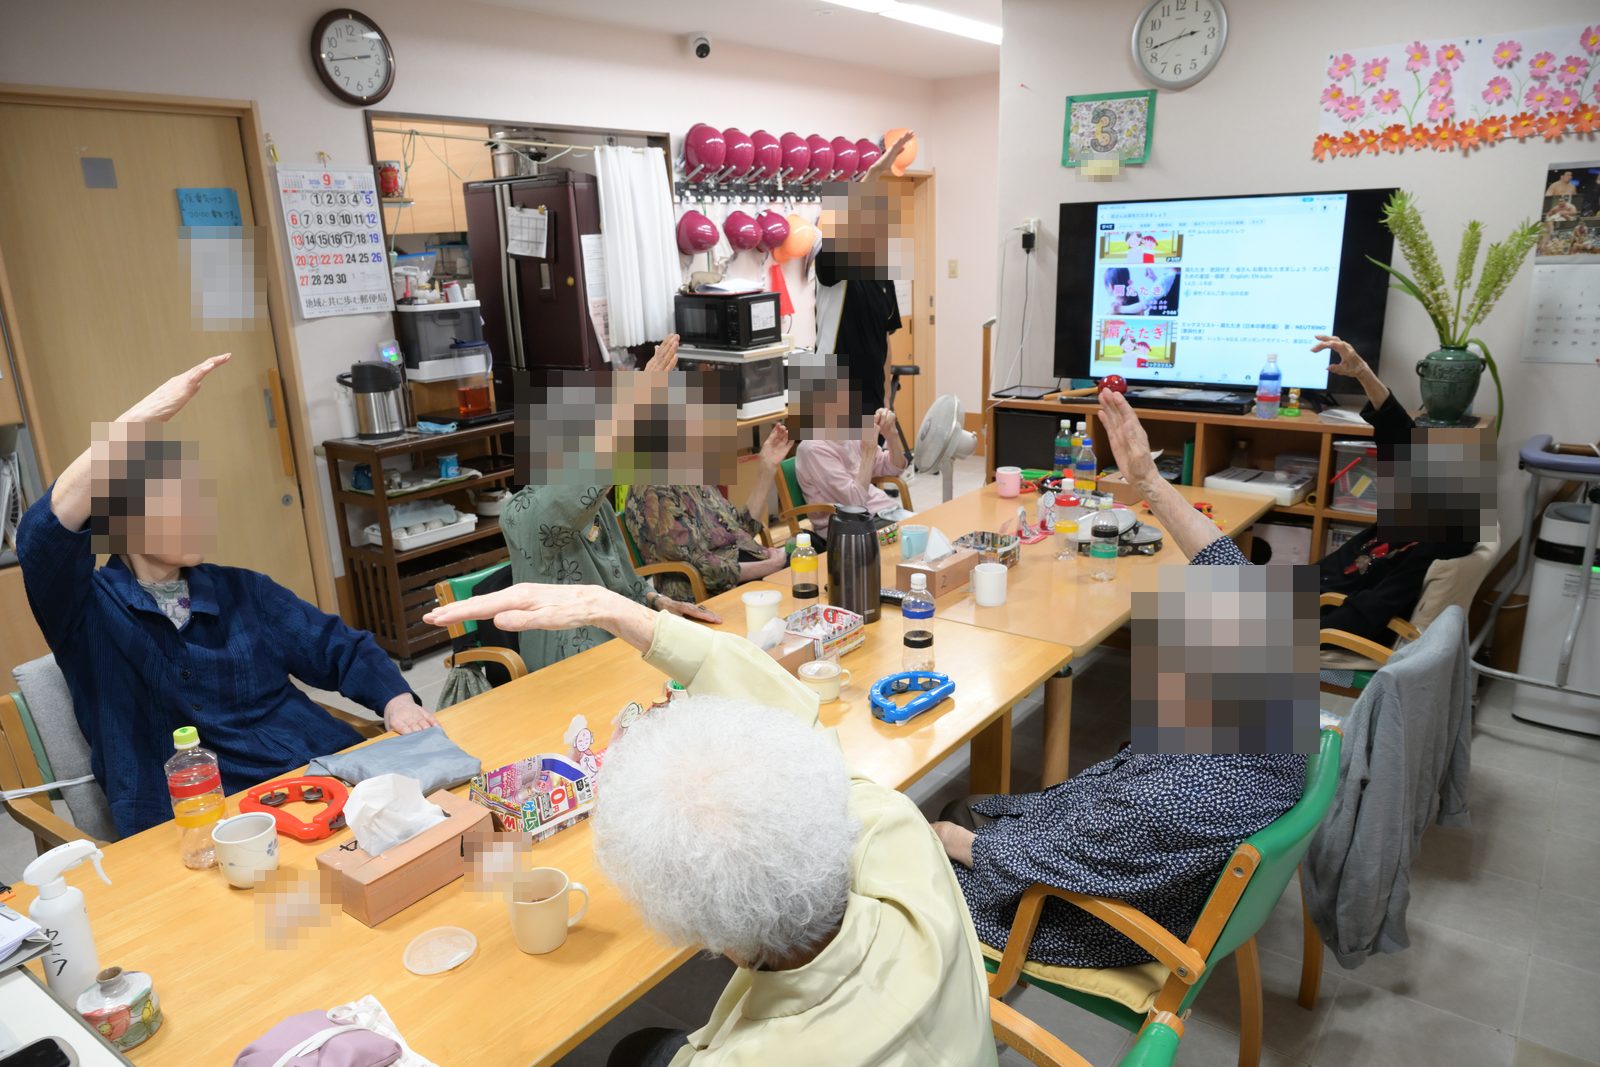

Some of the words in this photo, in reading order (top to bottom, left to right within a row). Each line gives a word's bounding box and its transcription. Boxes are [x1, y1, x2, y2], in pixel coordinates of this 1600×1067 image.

[1161, 5, 1170, 17] 11
[1175, 0, 1187, 11] 12
[1194, 0, 1199, 12] 1
[1203, 10, 1211, 23] 2
[345, 24, 355, 37] 12
[1150, 19, 1161, 31] 10
[335, 27, 343, 39] 11
[1207, 26, 1216, 39] 3
[327, 36, 338, 49] 10
[368, 40, 376, 51] 2
[1145, 36, 1154, 49] 9
[327, 51, 334, 62] 9
[374, 54, 381, 66] 3
[1150, 51, 1158, 63] 8
[1160, 62, 1168, 74] 7
[1173, 63, 1182, 76] 6
[1189, 58, 1197, 70] 5
[334, 65, 341, 77] 8
[374, 69, 381, 78] 4
[344, 76, 351, 87] 7
[356, 81, 364, 92] 6
[367, 78, 375, 89] 5
[1090, 108, 1118, 153] 3
[322, 173, 332, 186] 9
[314, 194, 320, 204] 1
[326, 194, 333, 204] 2
[339, 194, 346, 204] 3
[352, 194, 359, 204] 4
[364, 194, 372, 204] 5
[290, 214, 298, 225] 6
[303, 214, 310, 225] 7
[316, 214, 323, 225] 8
[329, 214, 336, 225] 9
[340, 214, 351, 225] 10
[354, 214, 364, 225] 11
[367, 213, 377, 224] 12
[292, 235, 304, 246] 13
[305, 235, 316, 246] 14
[317, 235, 328, 245] 15
[331, 235, 341, 246] 16
[344, 235, 353, 245] 17
[356, 234, 366, 244] 18
[369, 233, 380, 243] 19
[296, 255, 307, 266] 20
[308, 255, 319, 266] 21
[321, 254, 331, 265] 22
[333, 254, 344, 264] 23
[346, 253, 357, 263] 24
[359, 253, 369, 263] 25
[371, 252, 382, 262] 26
[300, 276, 309, 286] 27
[311, 275, 322, 285] 28
[323, 274, 334, 284] 29
[336, 273, 347, 283] 30
